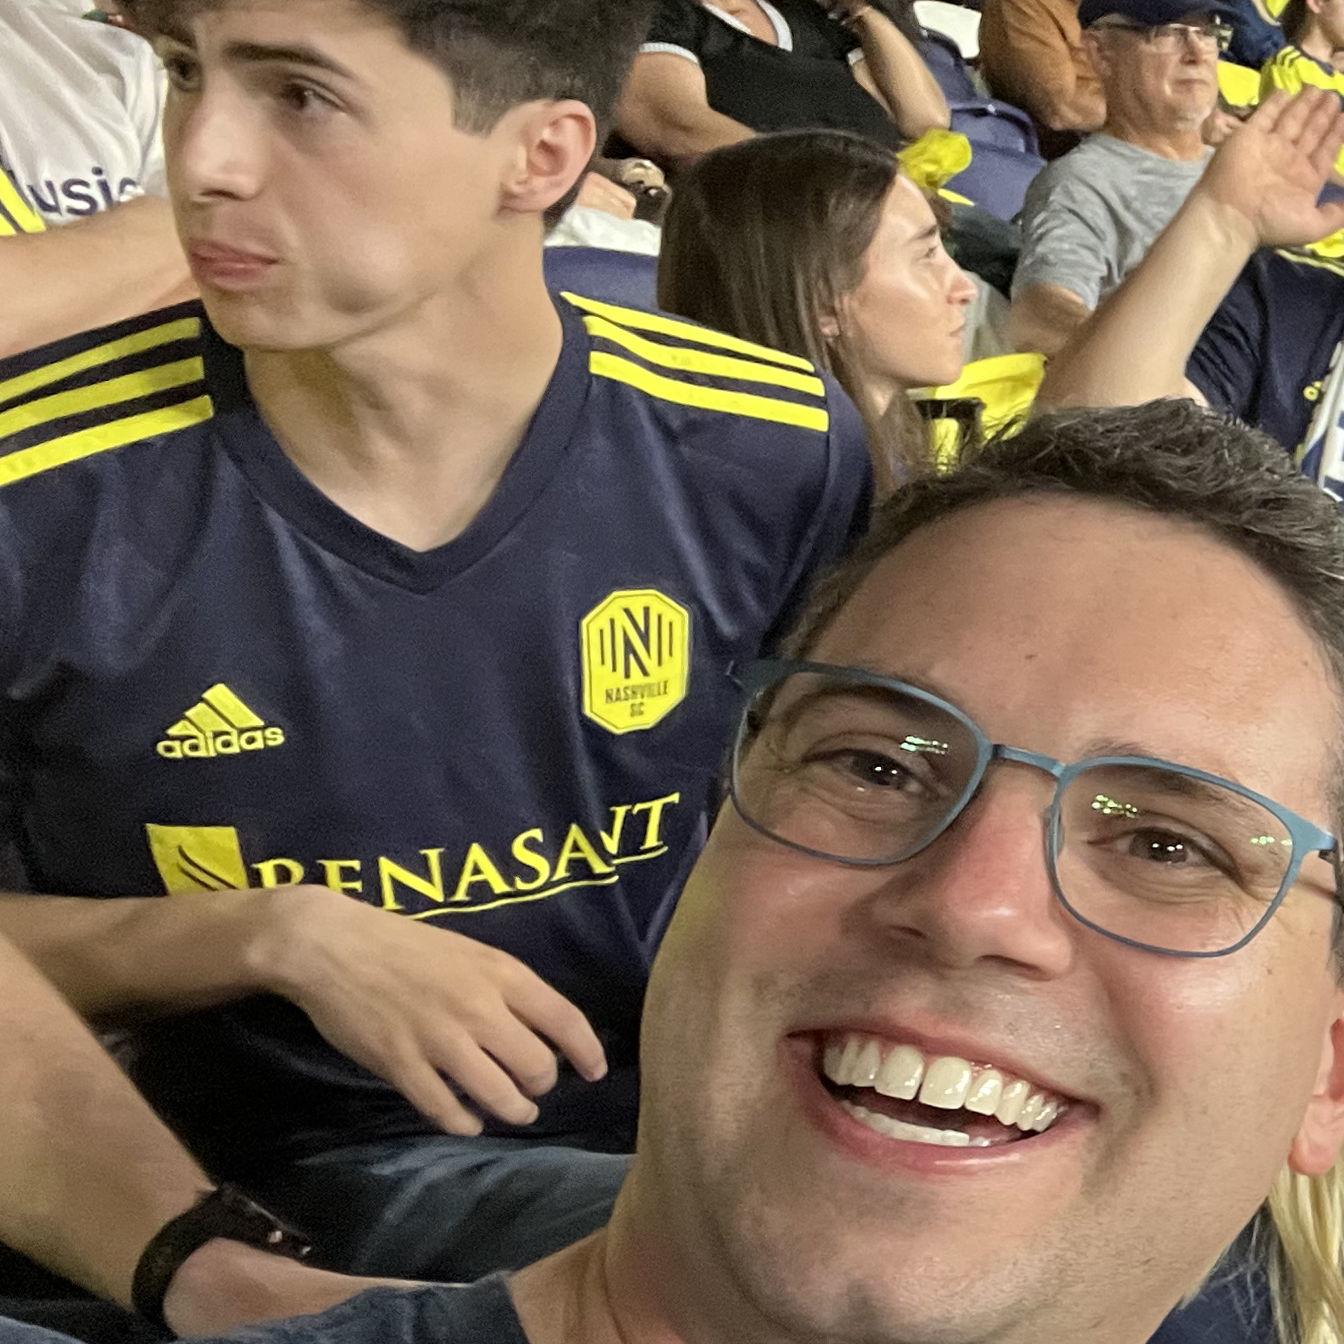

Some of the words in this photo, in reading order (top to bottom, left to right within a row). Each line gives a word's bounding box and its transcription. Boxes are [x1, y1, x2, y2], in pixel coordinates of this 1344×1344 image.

[604, 679, 669, 705] NASHVILLE
[630, 702, 645, 718] SC
[155, 723, 285, 759] adidas
